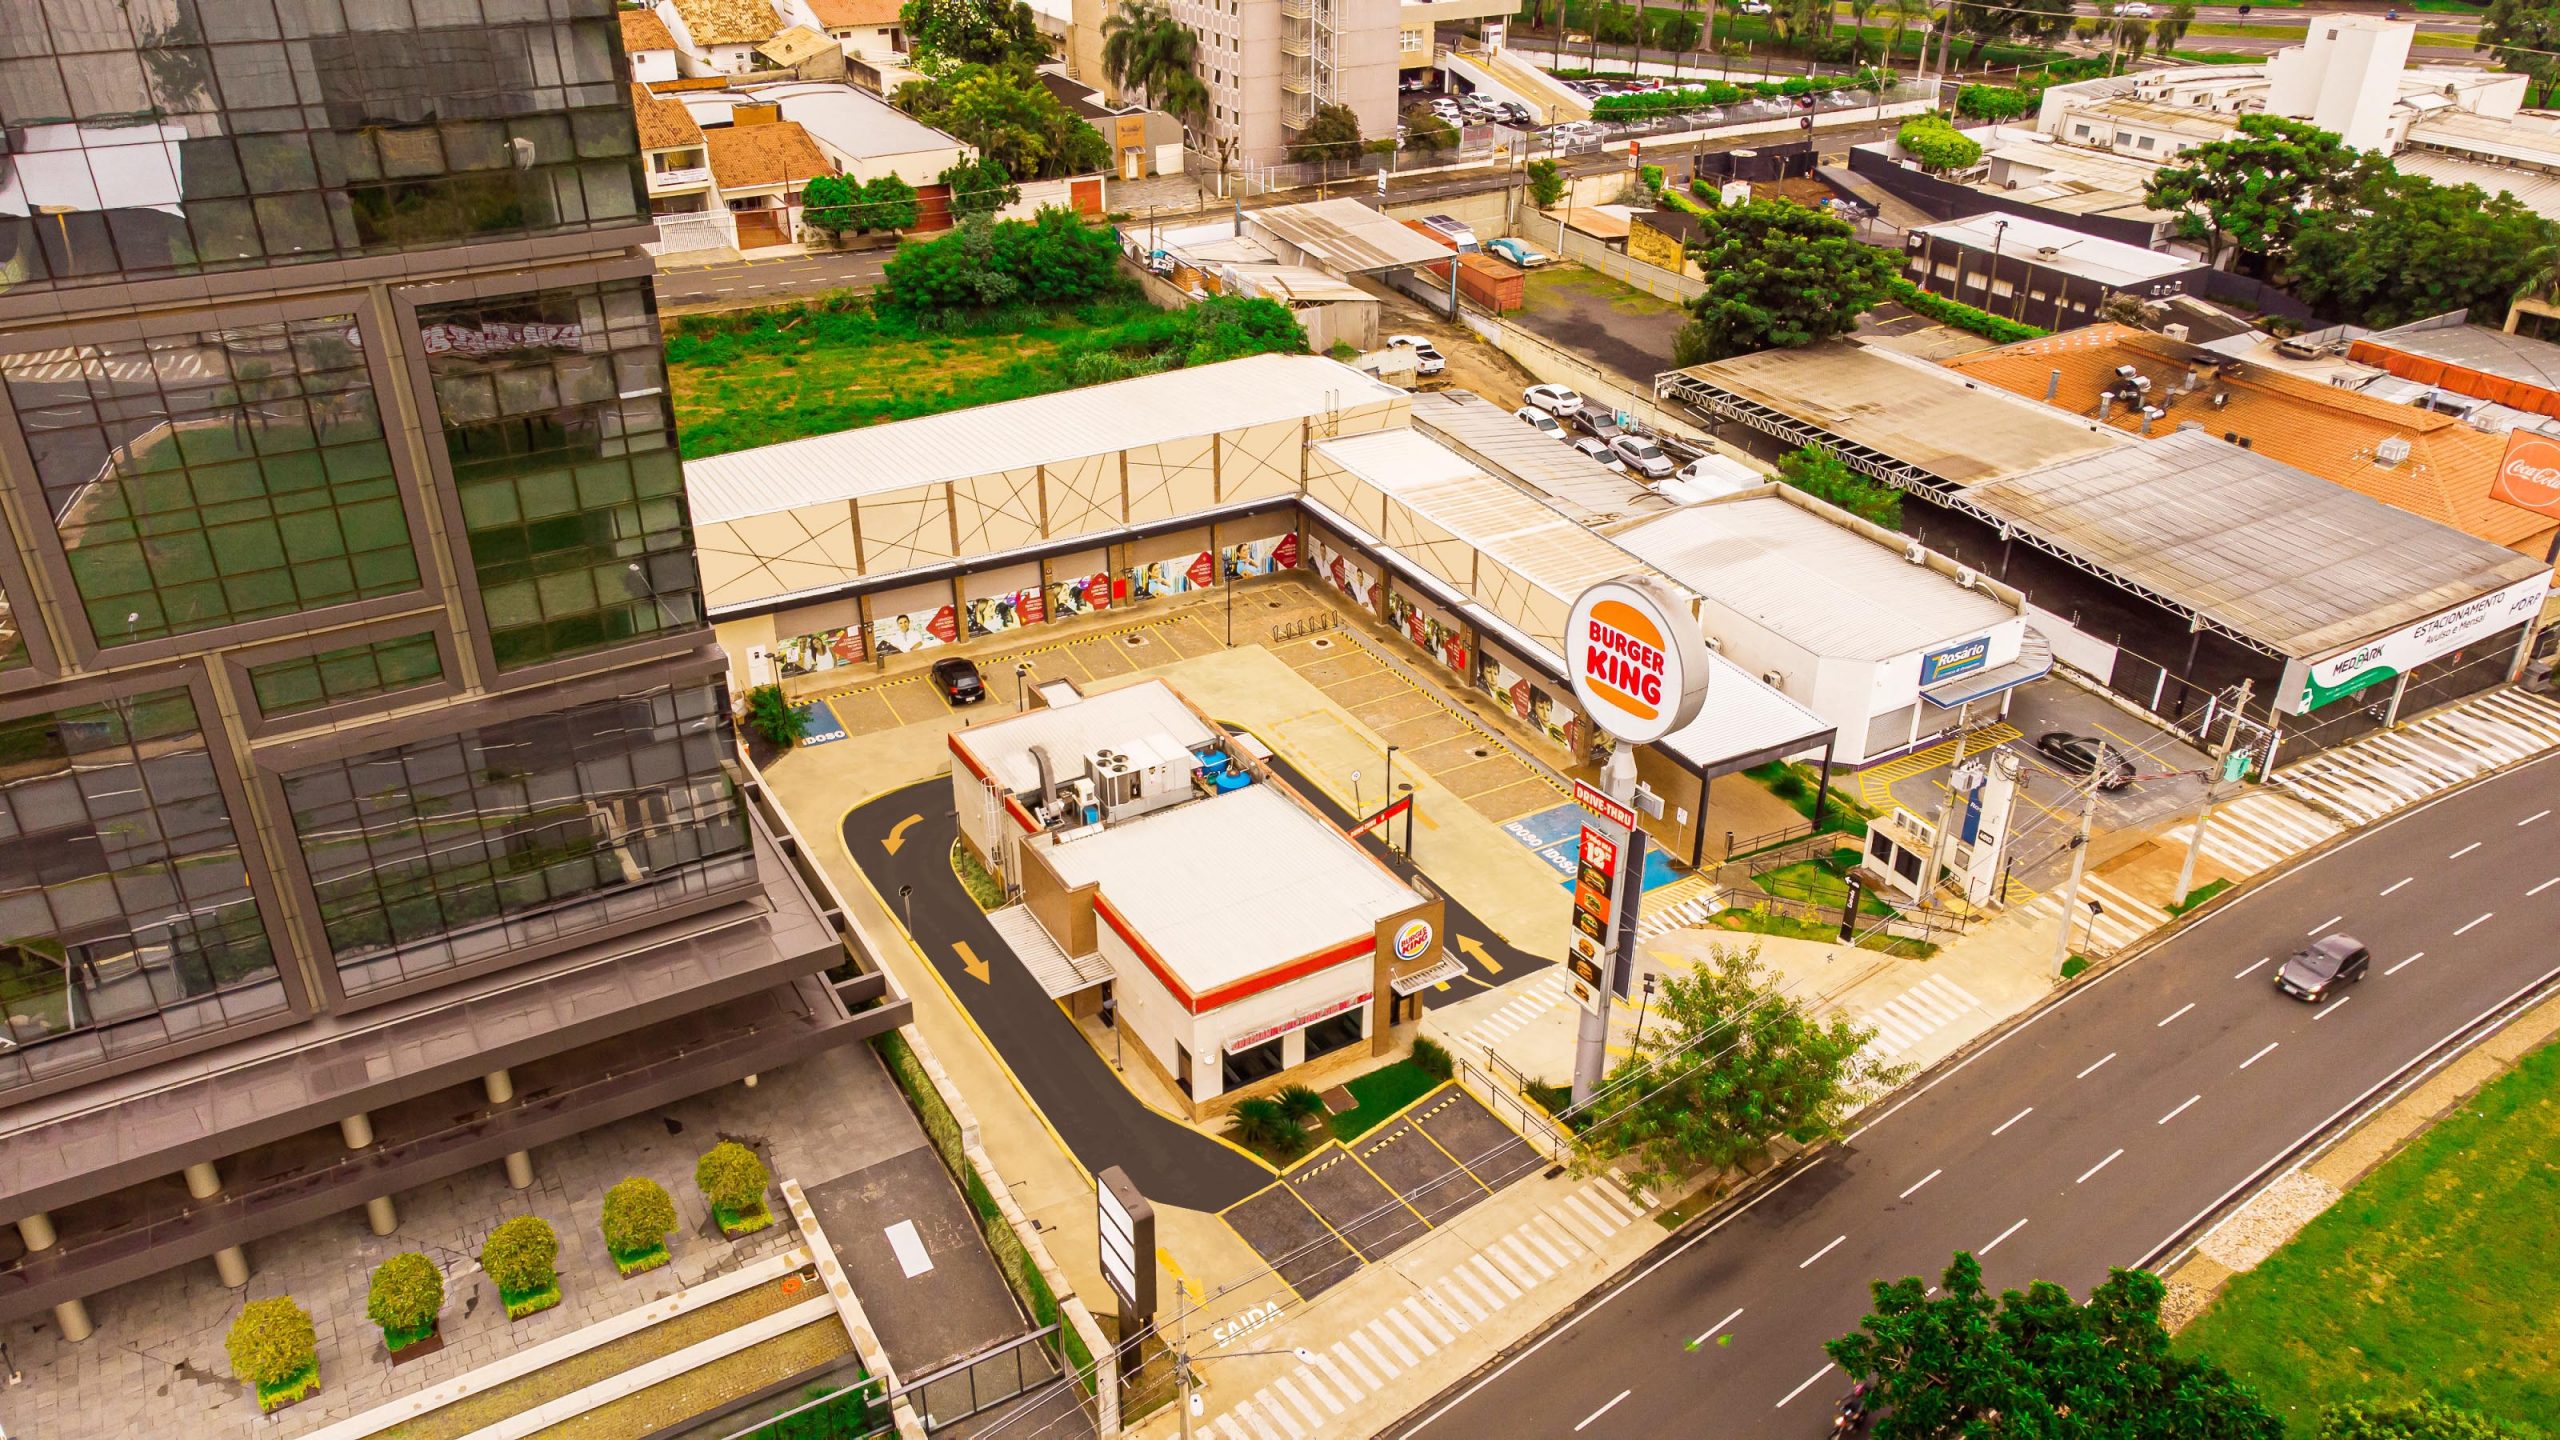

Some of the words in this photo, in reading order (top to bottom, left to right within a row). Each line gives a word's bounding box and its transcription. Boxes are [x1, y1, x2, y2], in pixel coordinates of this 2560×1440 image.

[2414, 591, 2505, 638] ESTACIONAMENTO
[2424, 628, 2452, 646] Avulso
[2459, 612, 2486, 630] Mensal
[1589, 620, 1665, 676] BURGER
[1939, 644, 1985, 666] Rosário
[2332, 643, 2386, 677] MEDPARK
[1587, 645, 1661, 706] KING
[801, 730, 846, 746] IDOSO
[1576, 786, 1632, 827] DRIVE-THRU
[1505, 821, 1543, 847] IDOSO
[1541, 847, 1578, 874] IDOSO
[1401, 926, 1427, 948] BURGER
[1402, 931, 1428, 954] KING
